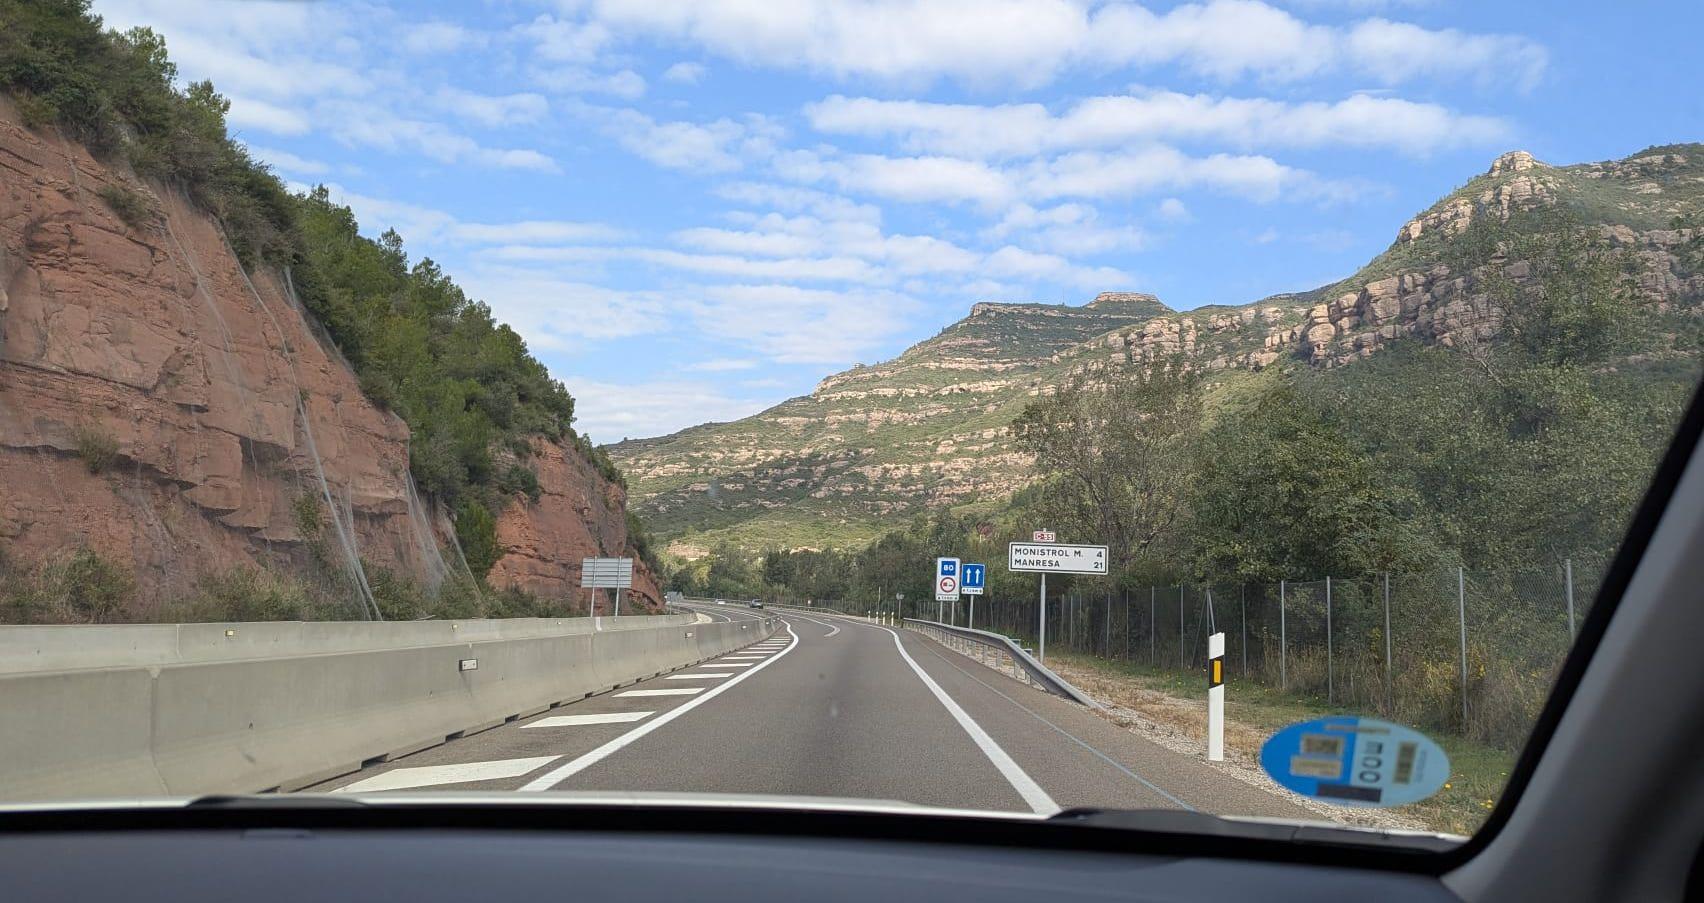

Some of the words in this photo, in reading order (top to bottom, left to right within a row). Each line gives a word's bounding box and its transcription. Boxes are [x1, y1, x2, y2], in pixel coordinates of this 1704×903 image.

[1014, 548, 1069, 557] MONISTROL
[1014, 559, 1060, 567] MANRESA
[1093, 561, 1103, 569] 21
